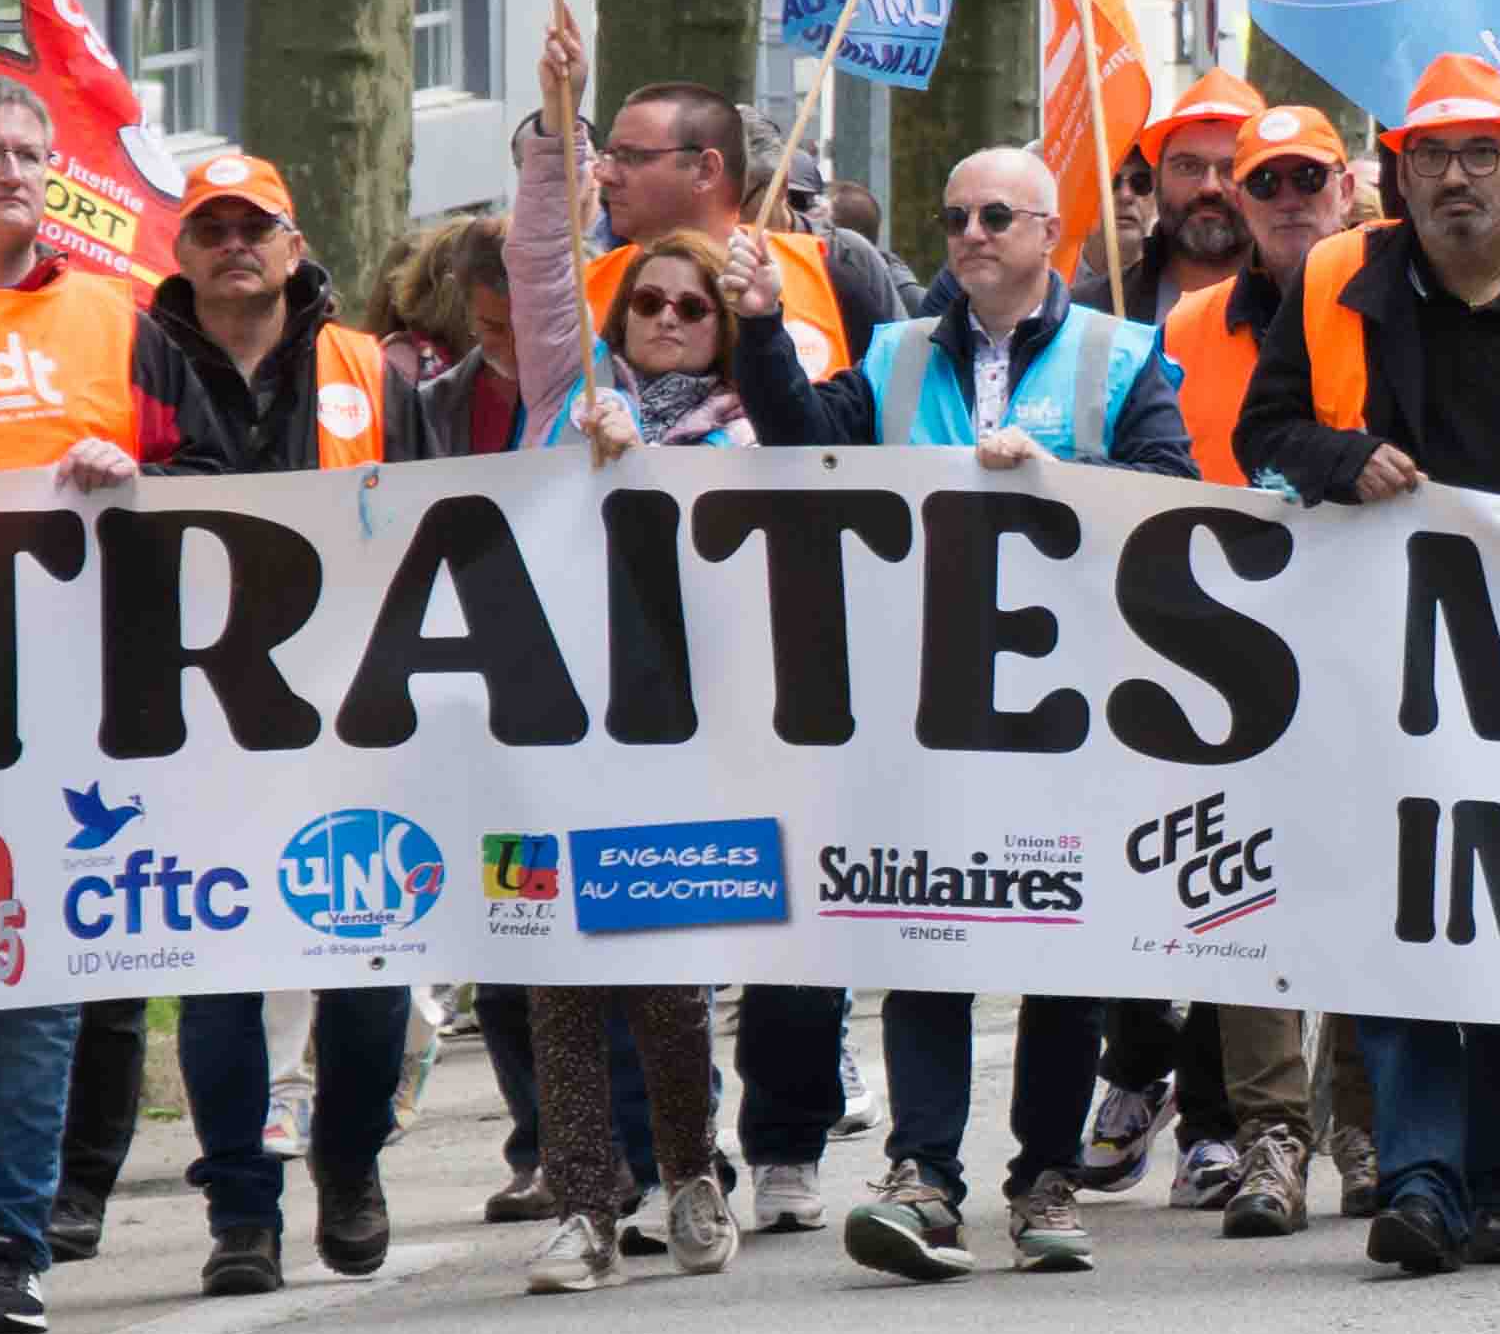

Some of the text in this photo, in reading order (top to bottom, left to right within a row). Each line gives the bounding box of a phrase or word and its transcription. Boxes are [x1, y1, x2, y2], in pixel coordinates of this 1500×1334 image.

[1004, 833, 1082, 850] Union 85
[1126, 792, 1226, 874] CFE
[1003, 848, 1084, 866] syndicale
[1177, 827, 1274, 910] CGC
[579, 878, 778, 901] AU QUOTIDIEN
[818, 845, 1084, 912] Solidaires
[62, 849, 250, 941] cftc
[899, 925, 968, 942] VENDÉE
[67, 946, 197, 977] UD Vendée
[1131, 935, 1158, 955] Le
[1185, 937, 1269, 961] syndical
